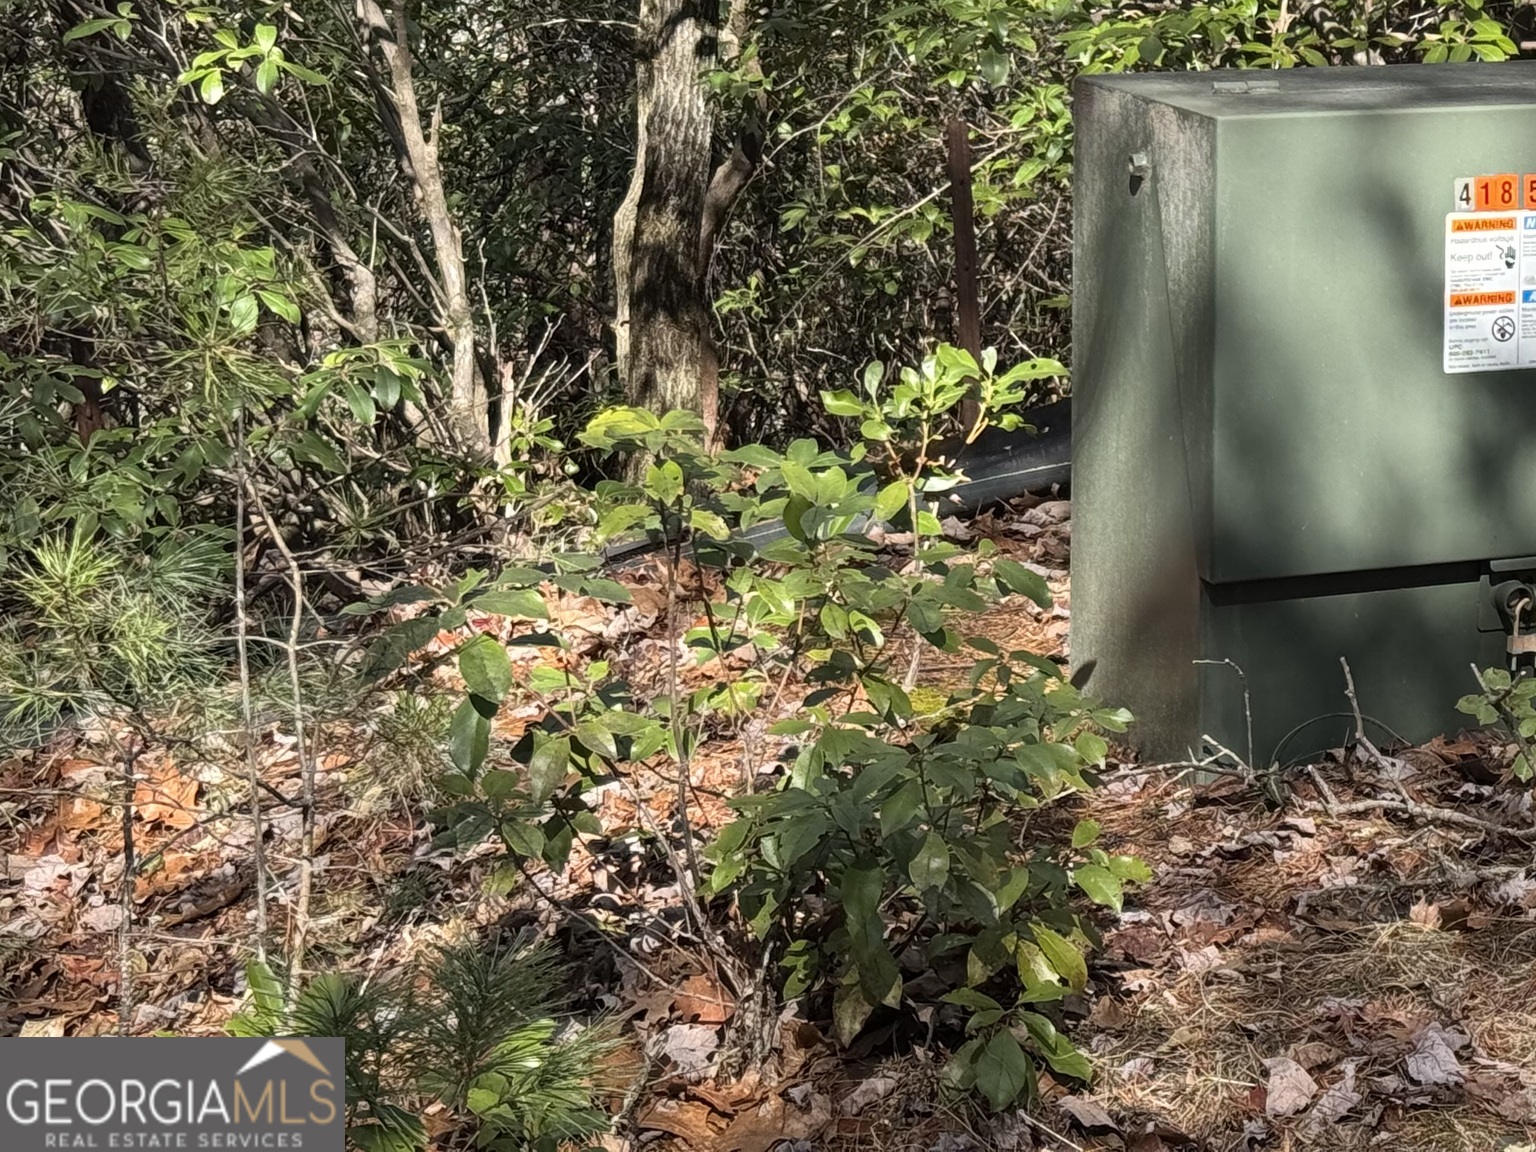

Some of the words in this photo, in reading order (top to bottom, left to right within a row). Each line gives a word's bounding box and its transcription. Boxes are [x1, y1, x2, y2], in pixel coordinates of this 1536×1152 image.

[1464, 219, 1514, 231] WARNING
[1450, 252, 1474, 264] Keep
[1475, 251, 1493, 261] out!
[1463, 292, 1513, 305] WARNING
